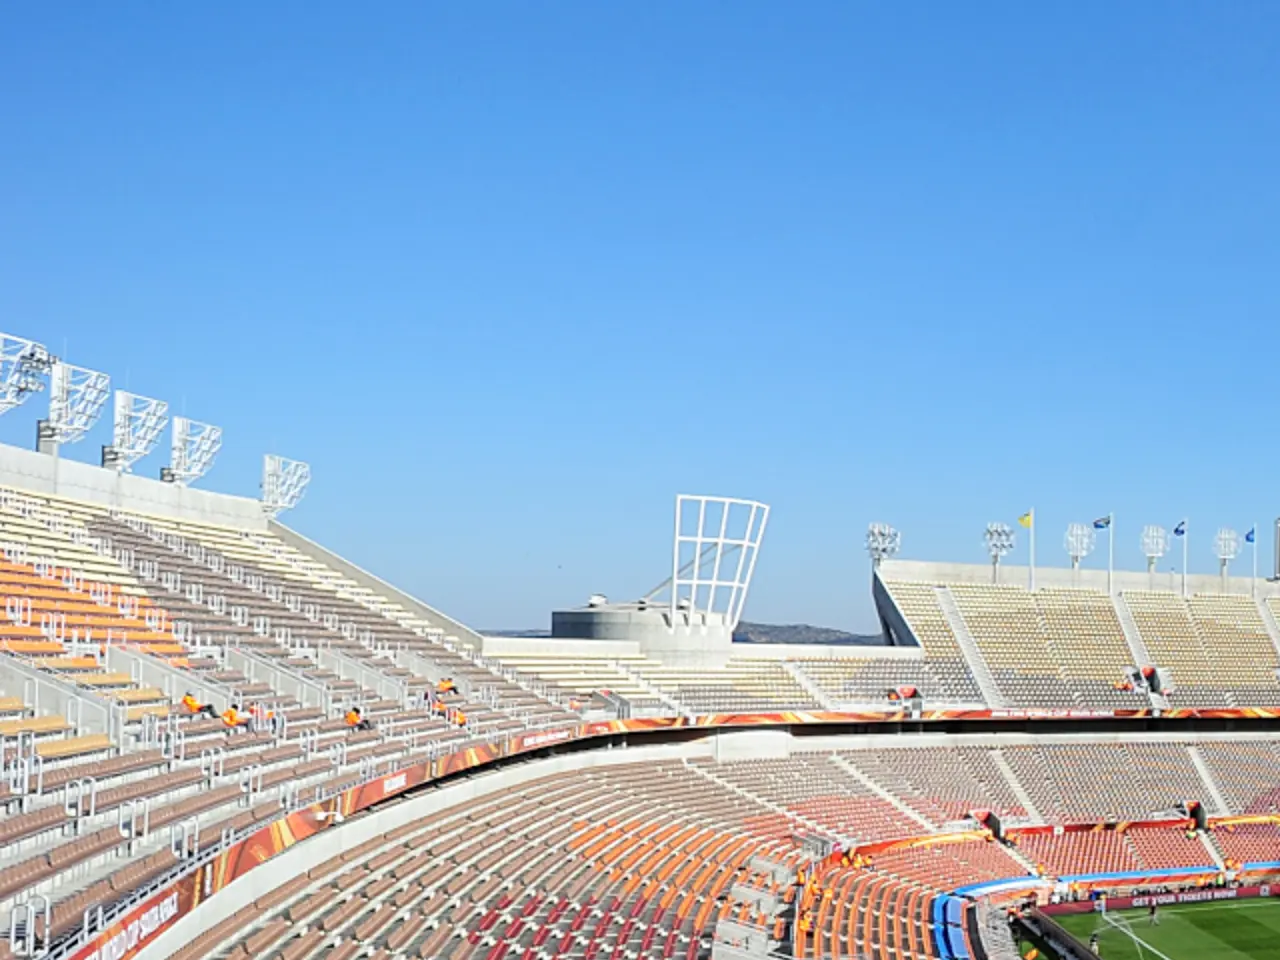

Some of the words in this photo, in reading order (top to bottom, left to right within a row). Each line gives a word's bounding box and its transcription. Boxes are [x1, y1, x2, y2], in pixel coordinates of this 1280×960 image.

[1132, 896, 1149, 907] GET
[1152, 894, 1176, 906] YOUR
[1178, 890, 1212, 903] TICKETS
